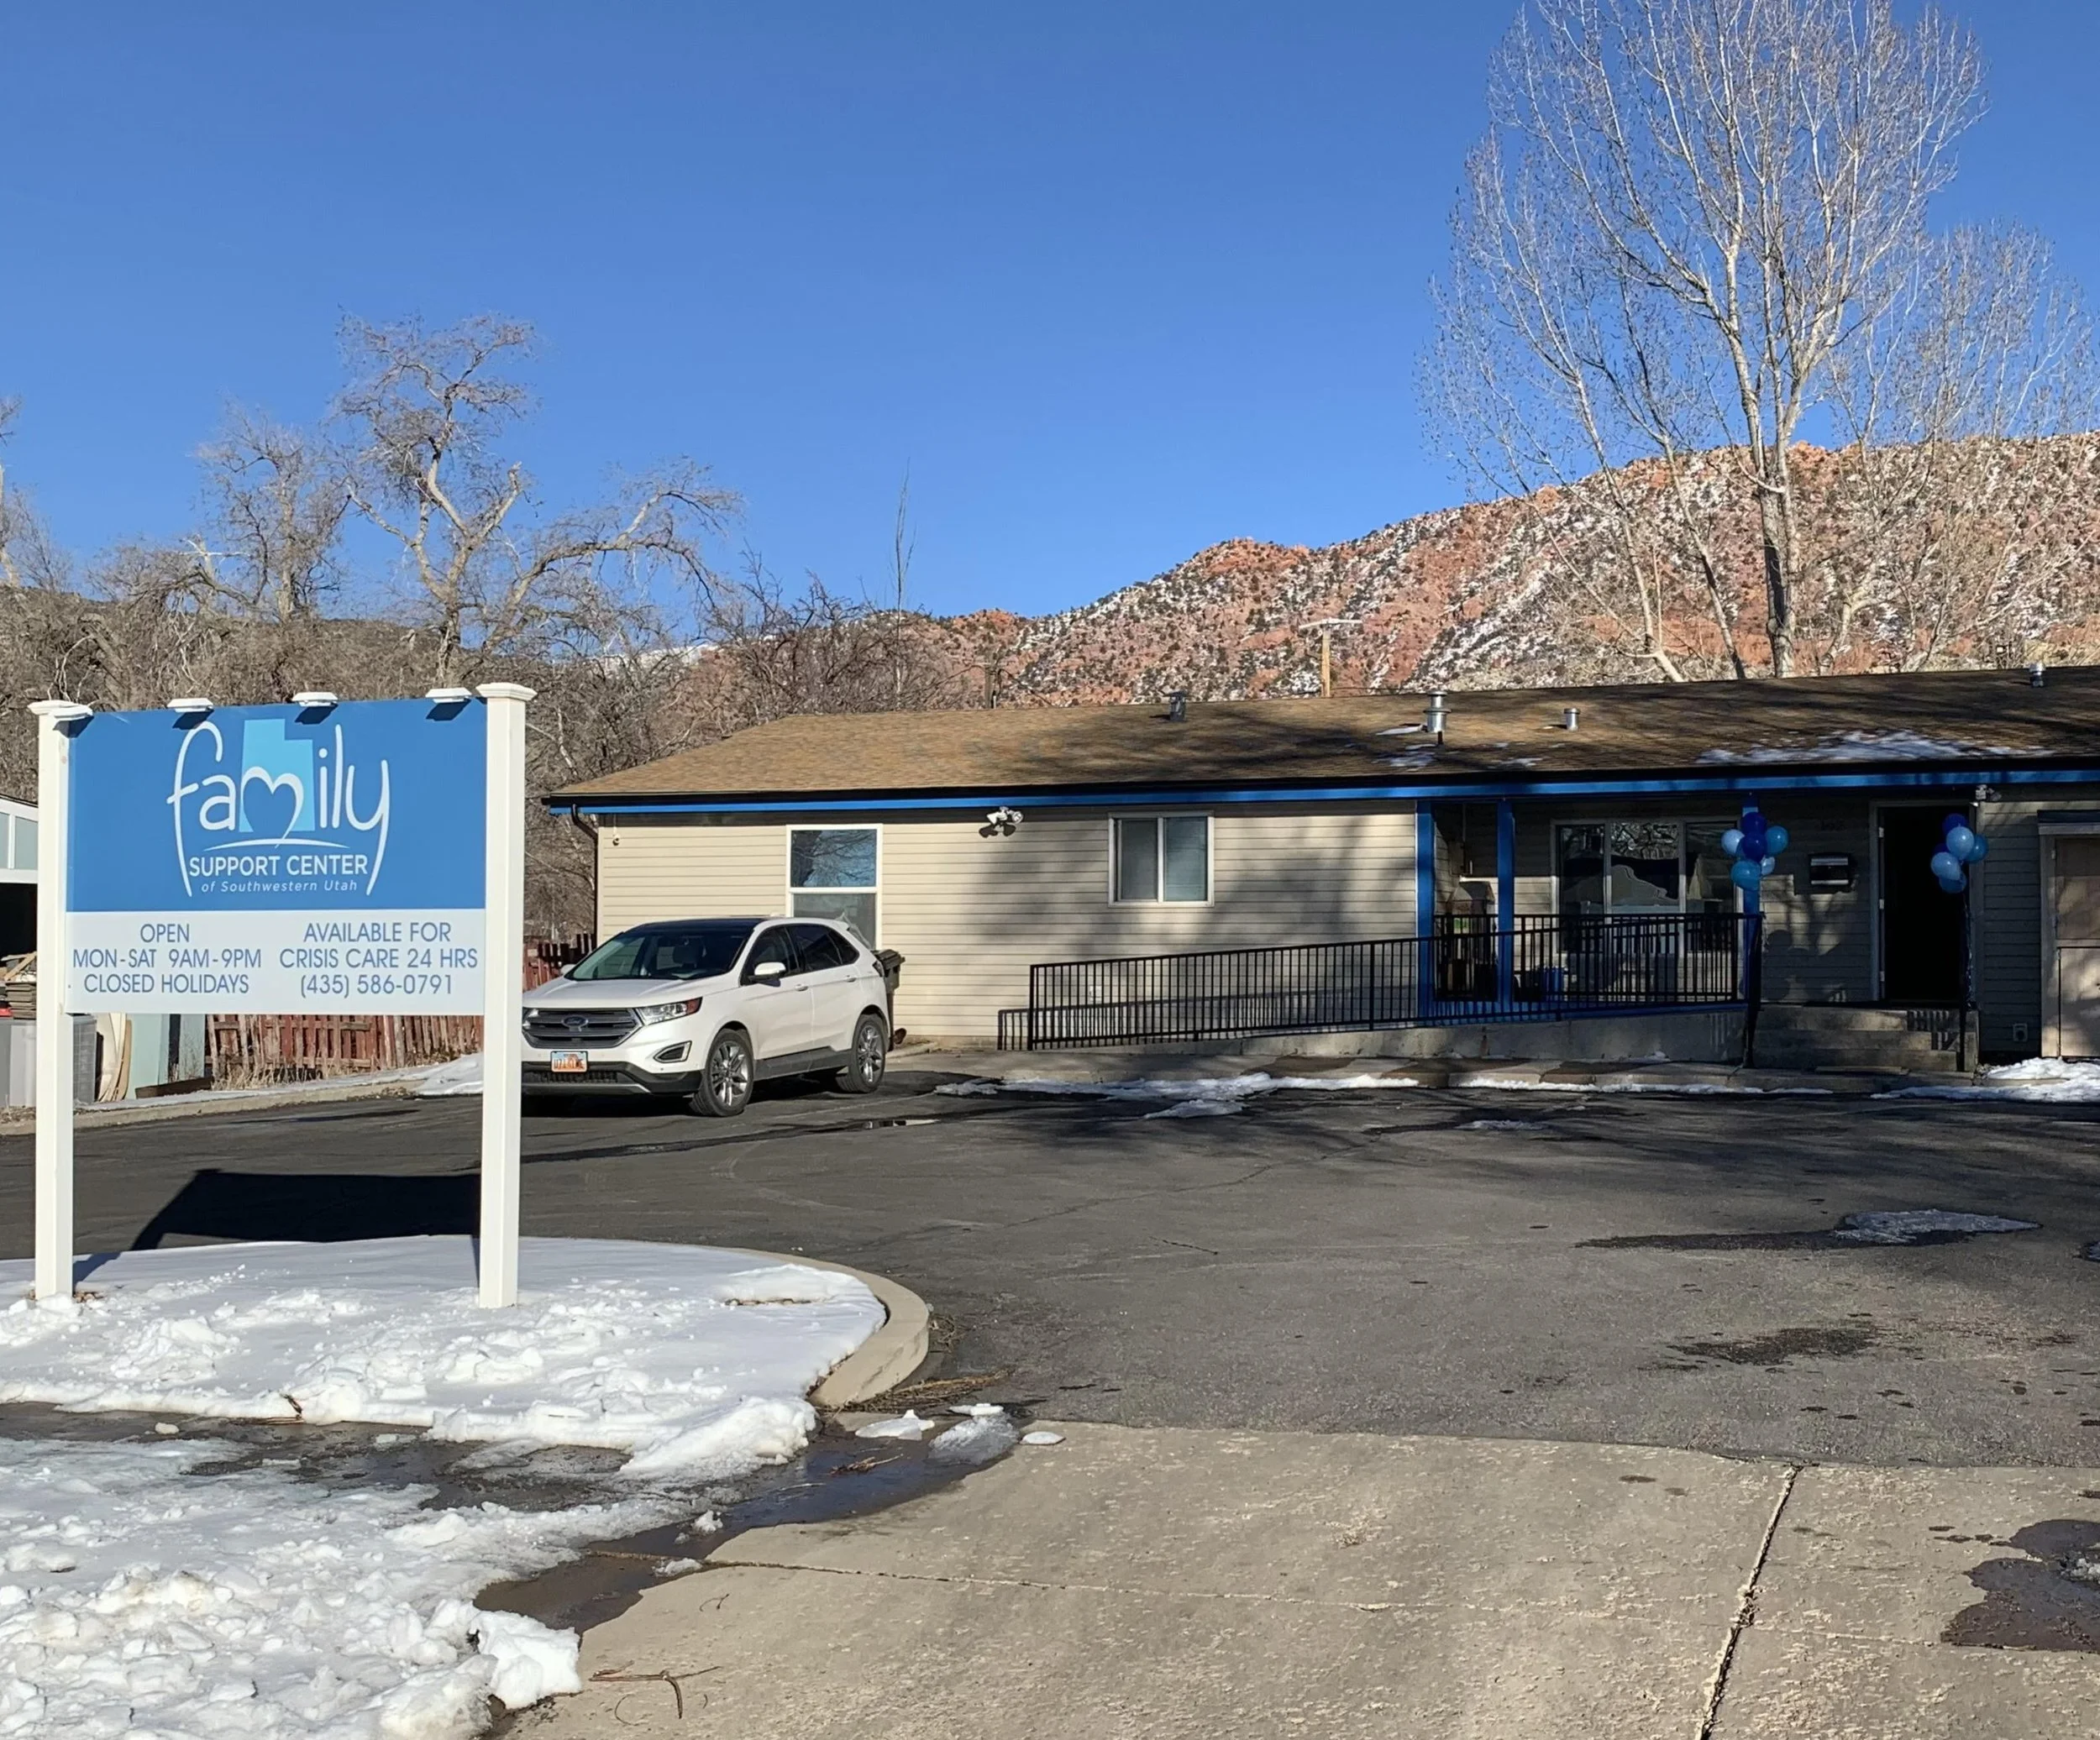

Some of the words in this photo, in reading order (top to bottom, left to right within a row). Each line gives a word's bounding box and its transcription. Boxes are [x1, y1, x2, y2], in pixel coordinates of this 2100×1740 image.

[166, 721, 390, 897] family
[189, 856, 281, 877] SUPPORT
[286, 854, 368, 876] CENTER
[201, 881, 217, 893] of
[221, 880, 318, 893] Southwestern
[324, 880, 357, 891] Utah
[140, 923, 190, 943] OPEN
[302, 922, 402, 943] AVAILABLE
[410, 921, 451, 942] FOR
[279, 948, 339, 968] CRISIS
[345, 947, 399, 968] CARE
[407, 947, 433, 968] 24
[439, 947, 478, 969] HRS
[83, 973, 155, 993] CLOSED
[160, 973, 249, 994] HOLIDAYS
[301, 974, 349, 998] (435)
[356, 974, 451, 995] 586-0791
